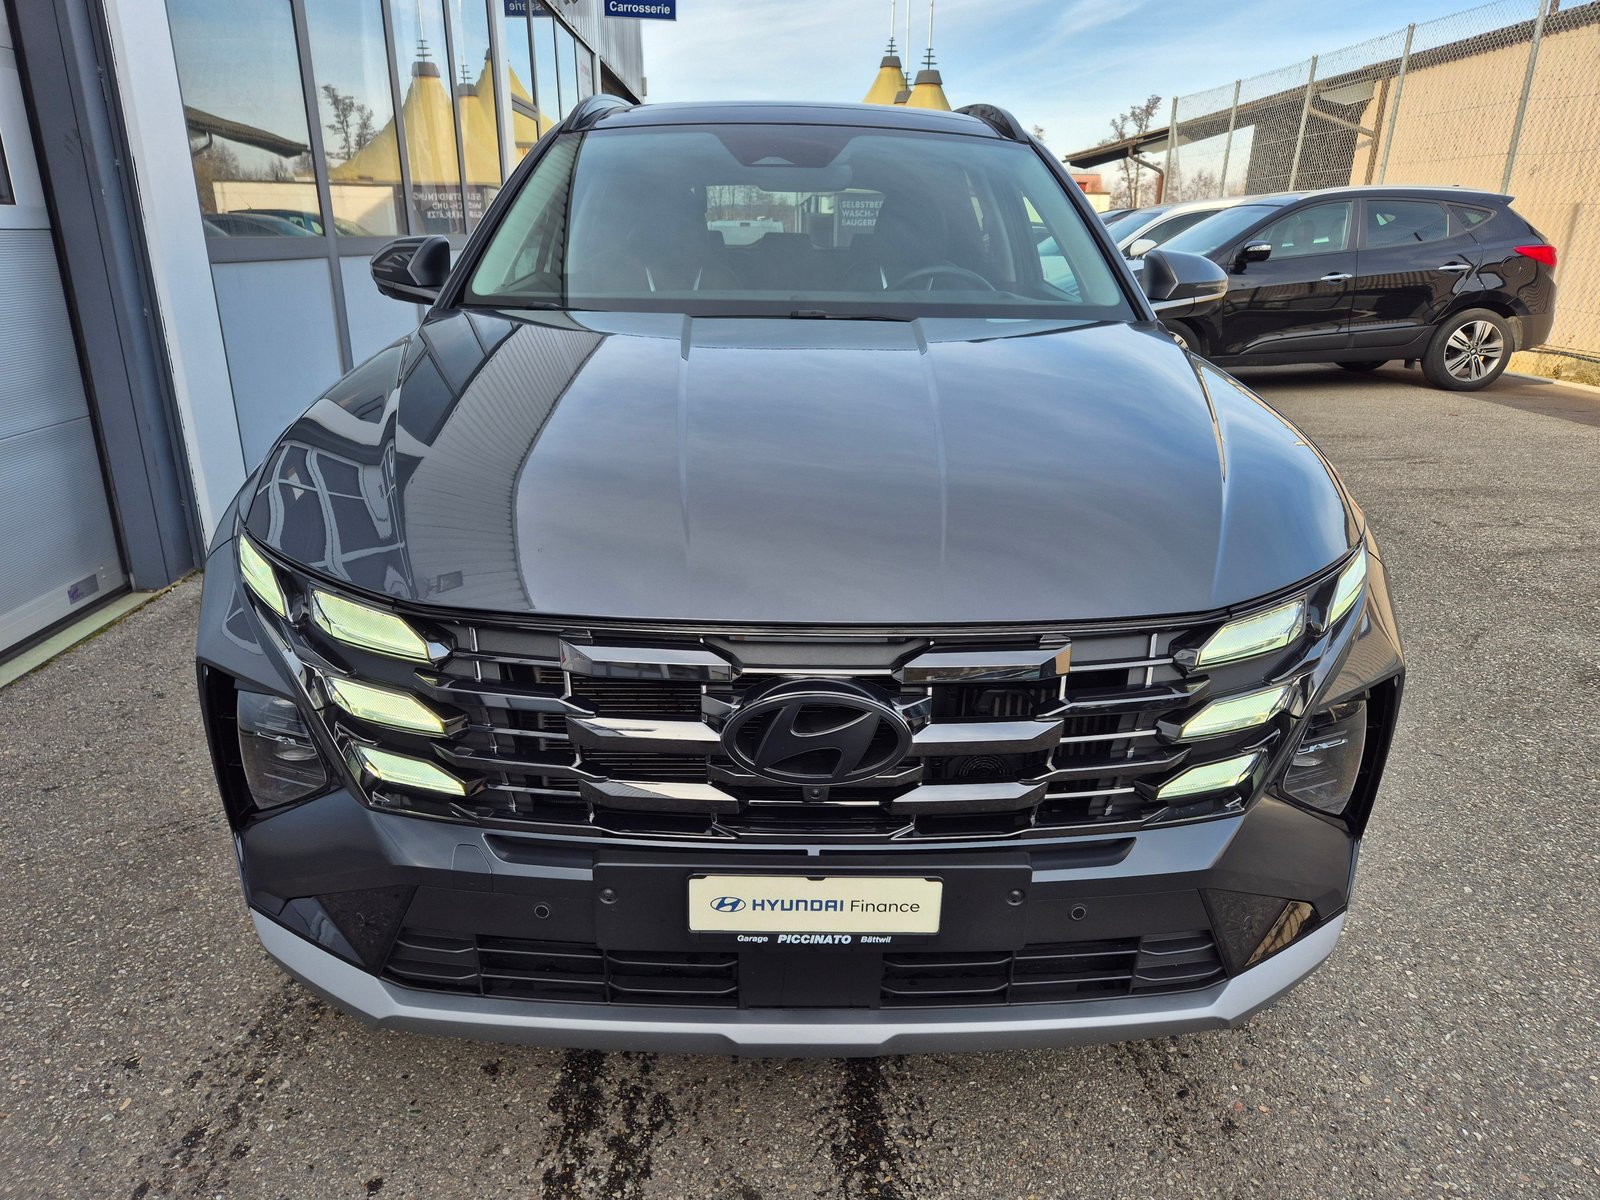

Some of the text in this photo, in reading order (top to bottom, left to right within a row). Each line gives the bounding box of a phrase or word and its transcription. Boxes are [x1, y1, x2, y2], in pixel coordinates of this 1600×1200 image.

[609, 1, 670, 14] Carrosserie
[752, 899, 920, 913] HYUNDAI Finance
[737, 934, 891, 945] Garage PICCINATO Bättwil
